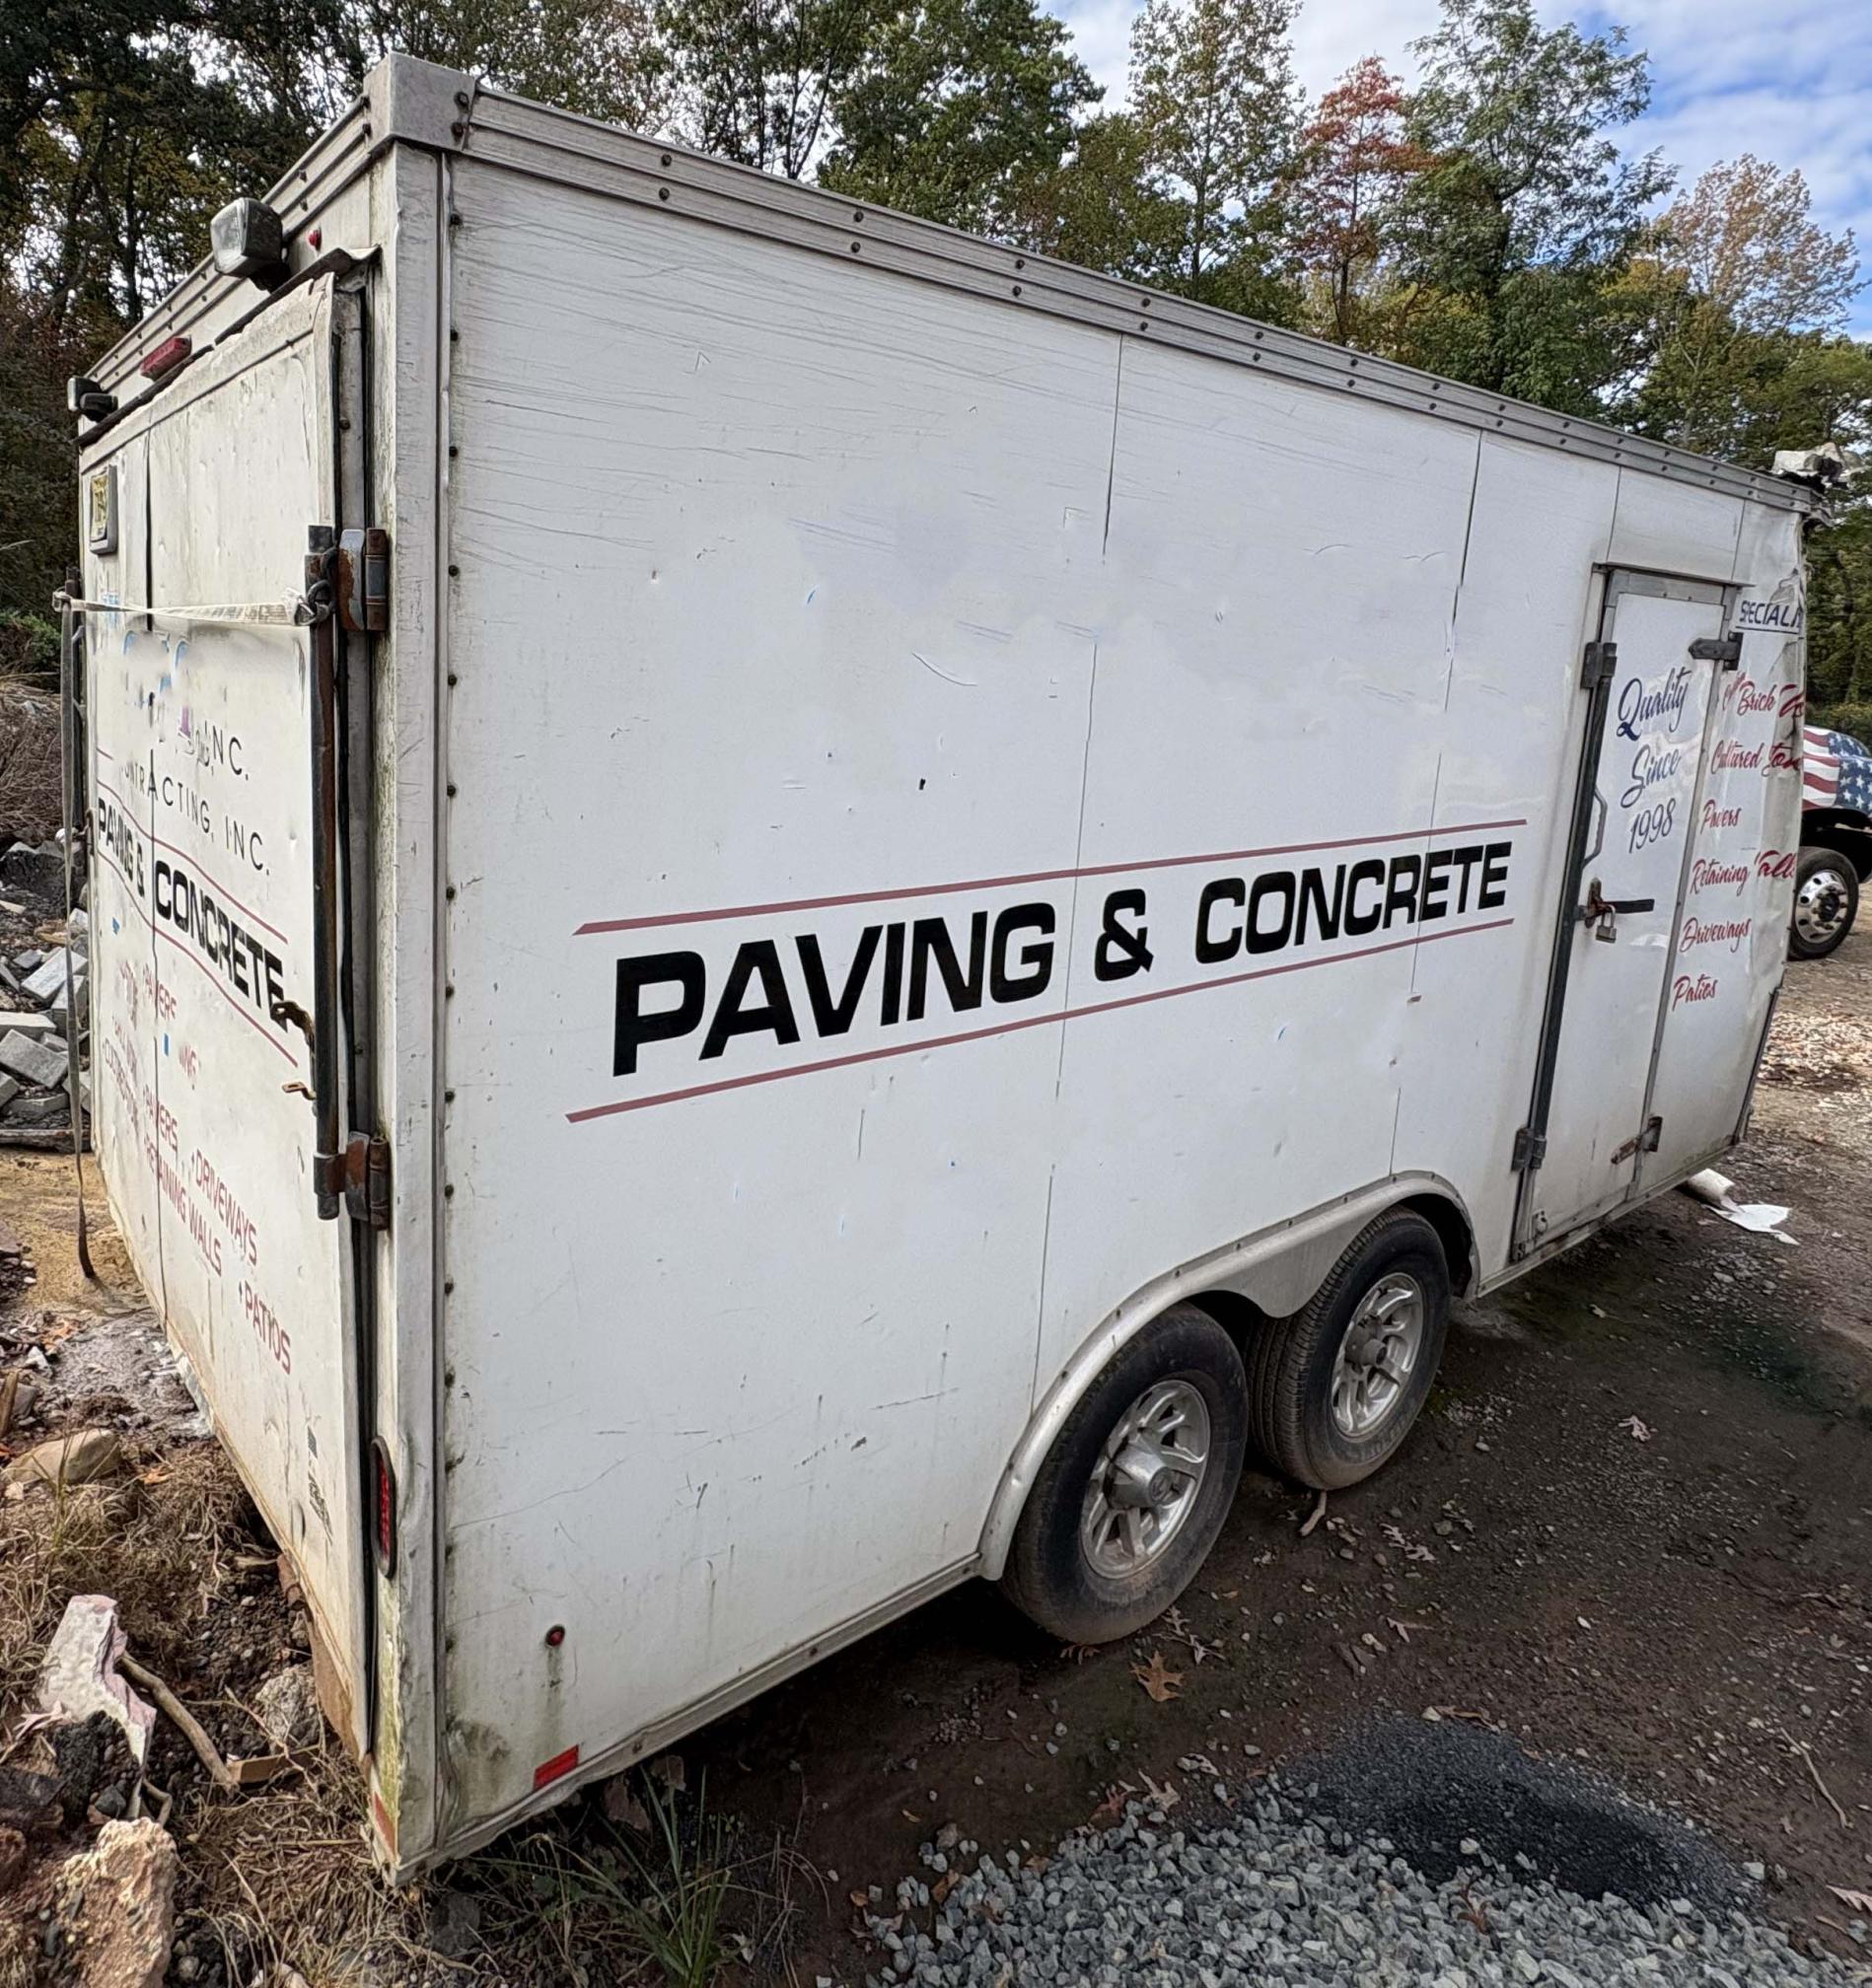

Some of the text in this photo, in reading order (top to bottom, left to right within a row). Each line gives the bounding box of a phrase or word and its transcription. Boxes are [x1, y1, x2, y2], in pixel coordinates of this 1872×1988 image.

[1617, 667, 1692, 741] Quality
[1737, 680, 1777, 716] Brick
[1620, 745, 1680, 808] Since
[1710, 741, 1763, 775] Cultured
[225, 816, 270, 876] INC.
[1629, 798, 1677, 854] 1998
[1701, 800, 1742, 834] Pavers
[1690, 859, 1750, 896] Retaining
[98, 797, 134, 882] PAVING
[155, 860, 289, 1033] CONCRETE
[1680, 917, 1752, 953] Driveways
[612, 841, 1513, 1077] PAVING & CONCRETE
[1673, 973, 1718, 1012] Patios
[187, 1196, 222, 1277] WALLS
[195, 1148, 257, 1266] DRIVEWAYS
[245, 1280, 291, 1375] PATIOS
